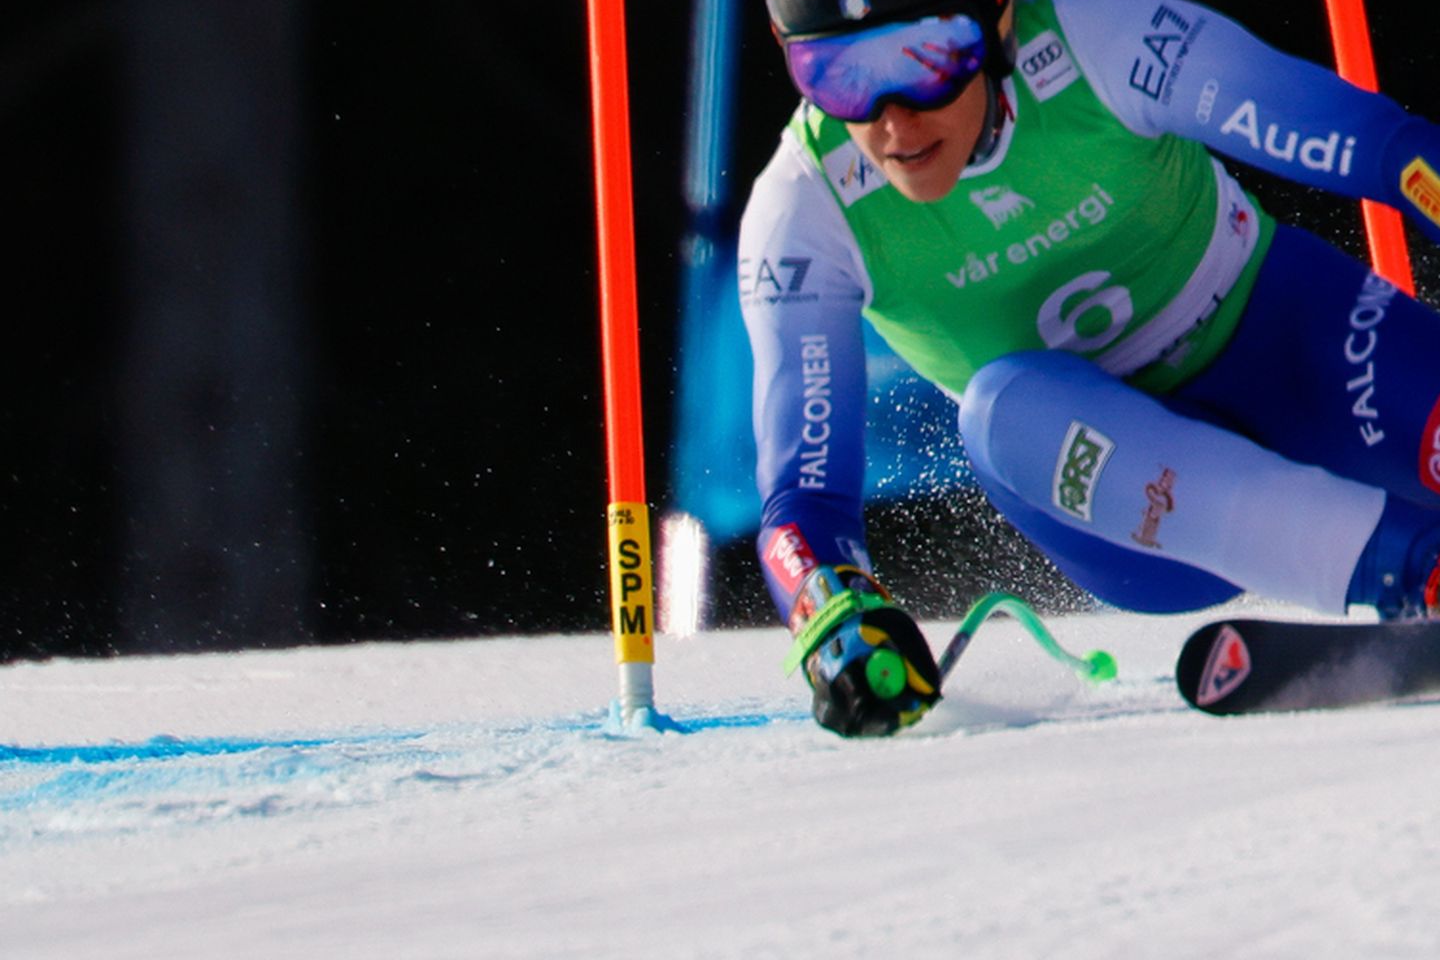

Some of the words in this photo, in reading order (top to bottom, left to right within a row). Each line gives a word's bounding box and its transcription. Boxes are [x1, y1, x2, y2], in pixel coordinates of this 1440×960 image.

[1219, 99, 1357, 177] Audi
[946, 251, 999, 288] vår
[1006, 182, 1115, 265] energi
[1036, 269, 1134, 353] 6
[799, 334, 832, 490] FALCONERI
